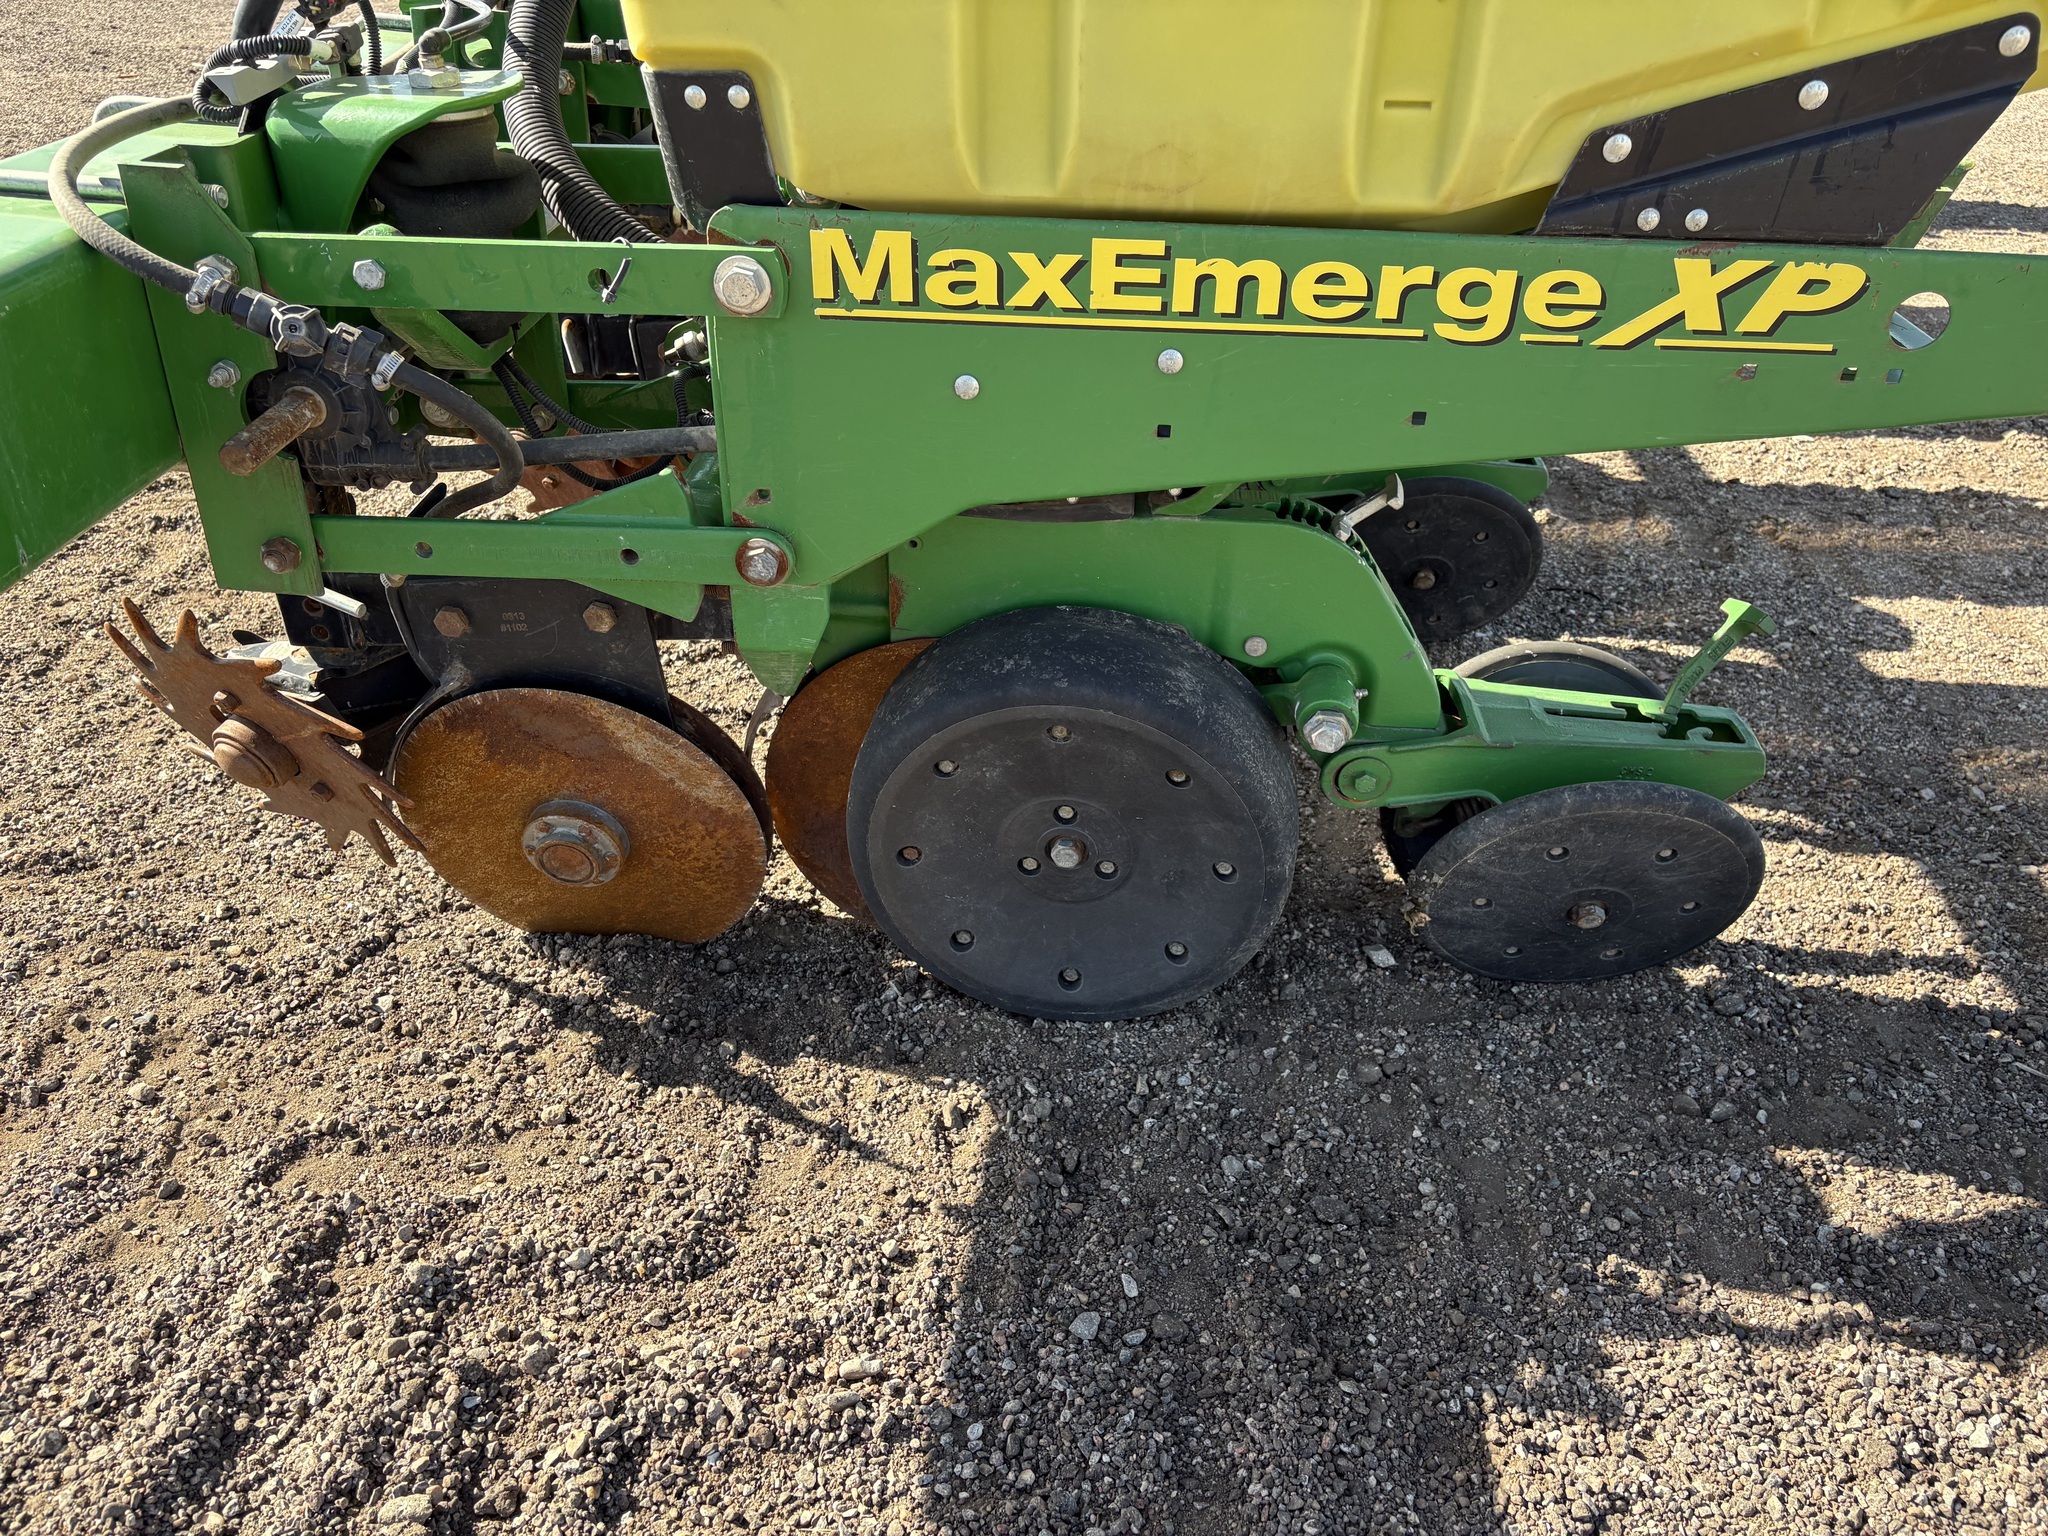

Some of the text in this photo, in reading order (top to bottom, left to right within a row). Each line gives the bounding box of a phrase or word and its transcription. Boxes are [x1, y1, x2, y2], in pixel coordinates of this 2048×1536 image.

[281, 13, 296, 31] SWITCH
[285, 19, 299, 36] HEIGH
[808, 227, 1605, 345] MaxEmerge
[1590, 258, 1870, 349] XP
